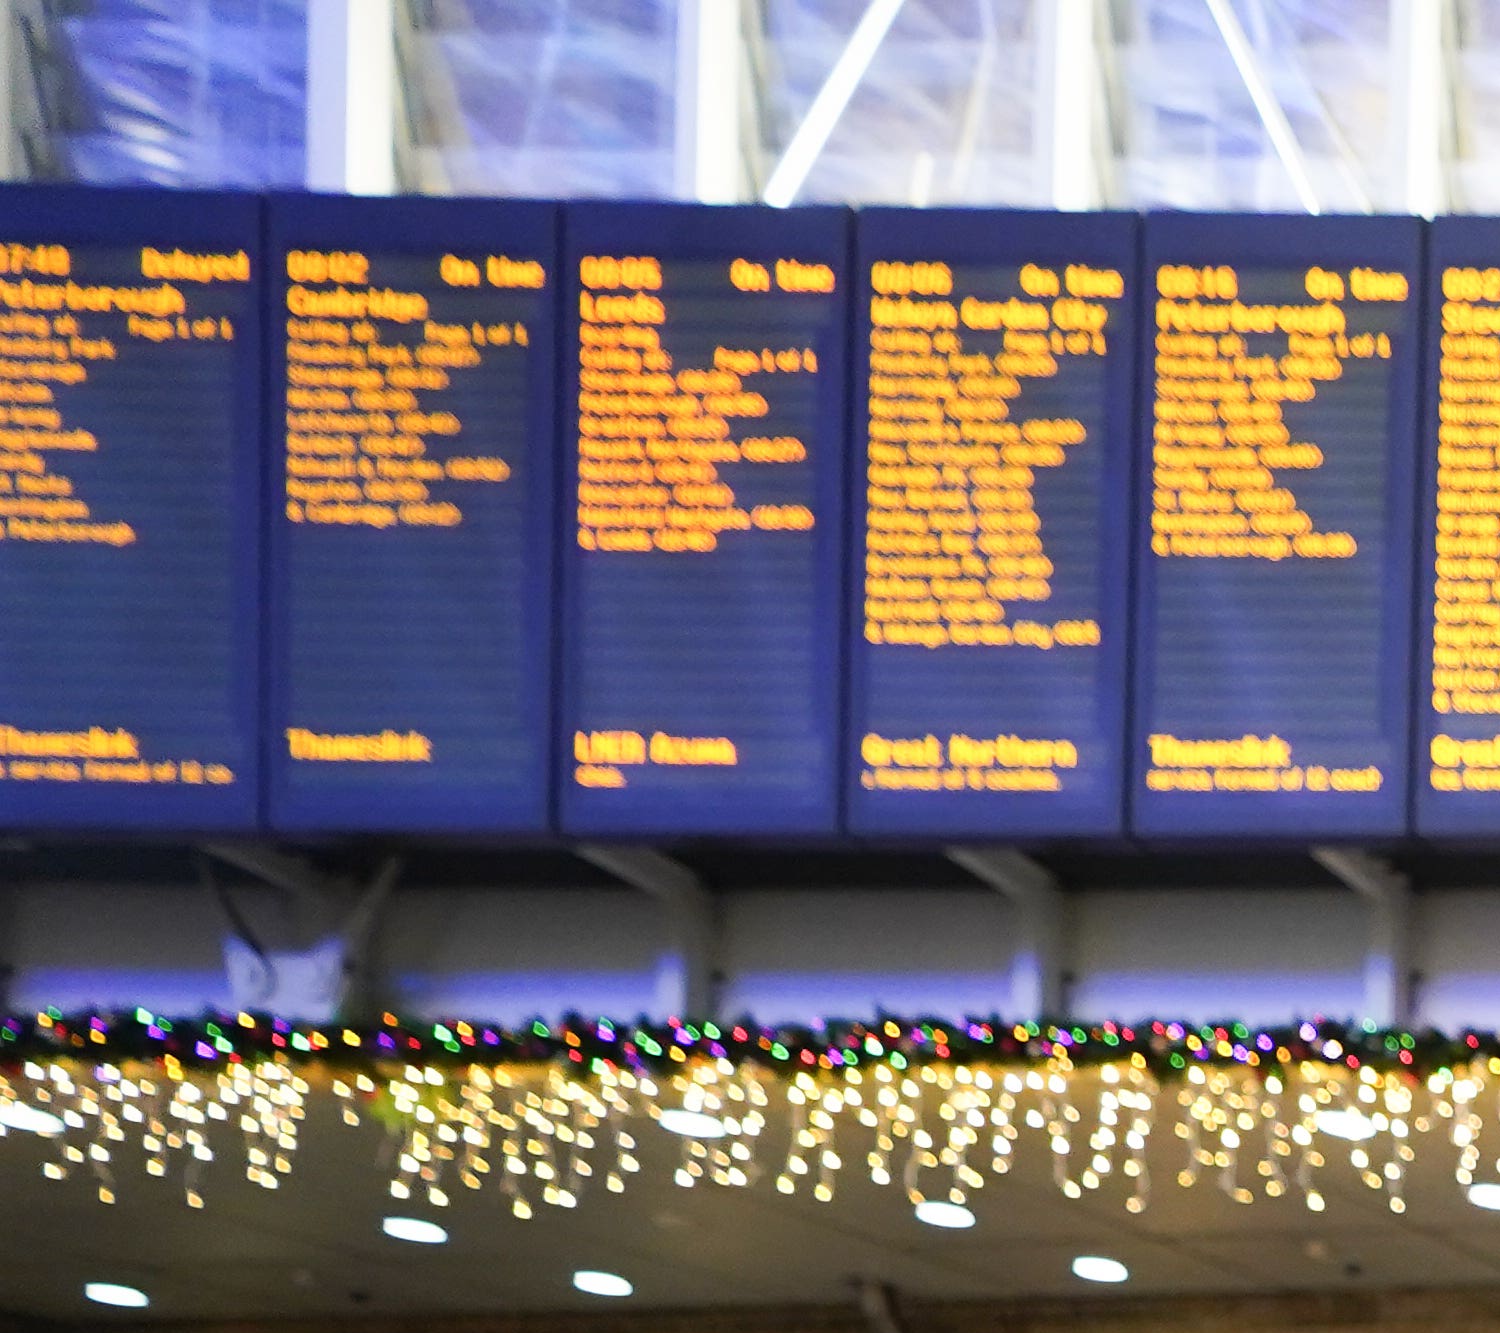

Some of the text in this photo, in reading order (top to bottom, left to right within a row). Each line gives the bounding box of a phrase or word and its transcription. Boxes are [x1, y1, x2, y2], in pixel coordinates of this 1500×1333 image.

[140, 247, 251, 282] Delayed
[0, 280, 187, 317] eterborough
[286, 284, 430, 324] Cambridge
[580, 290, 667, 326] Leeds
